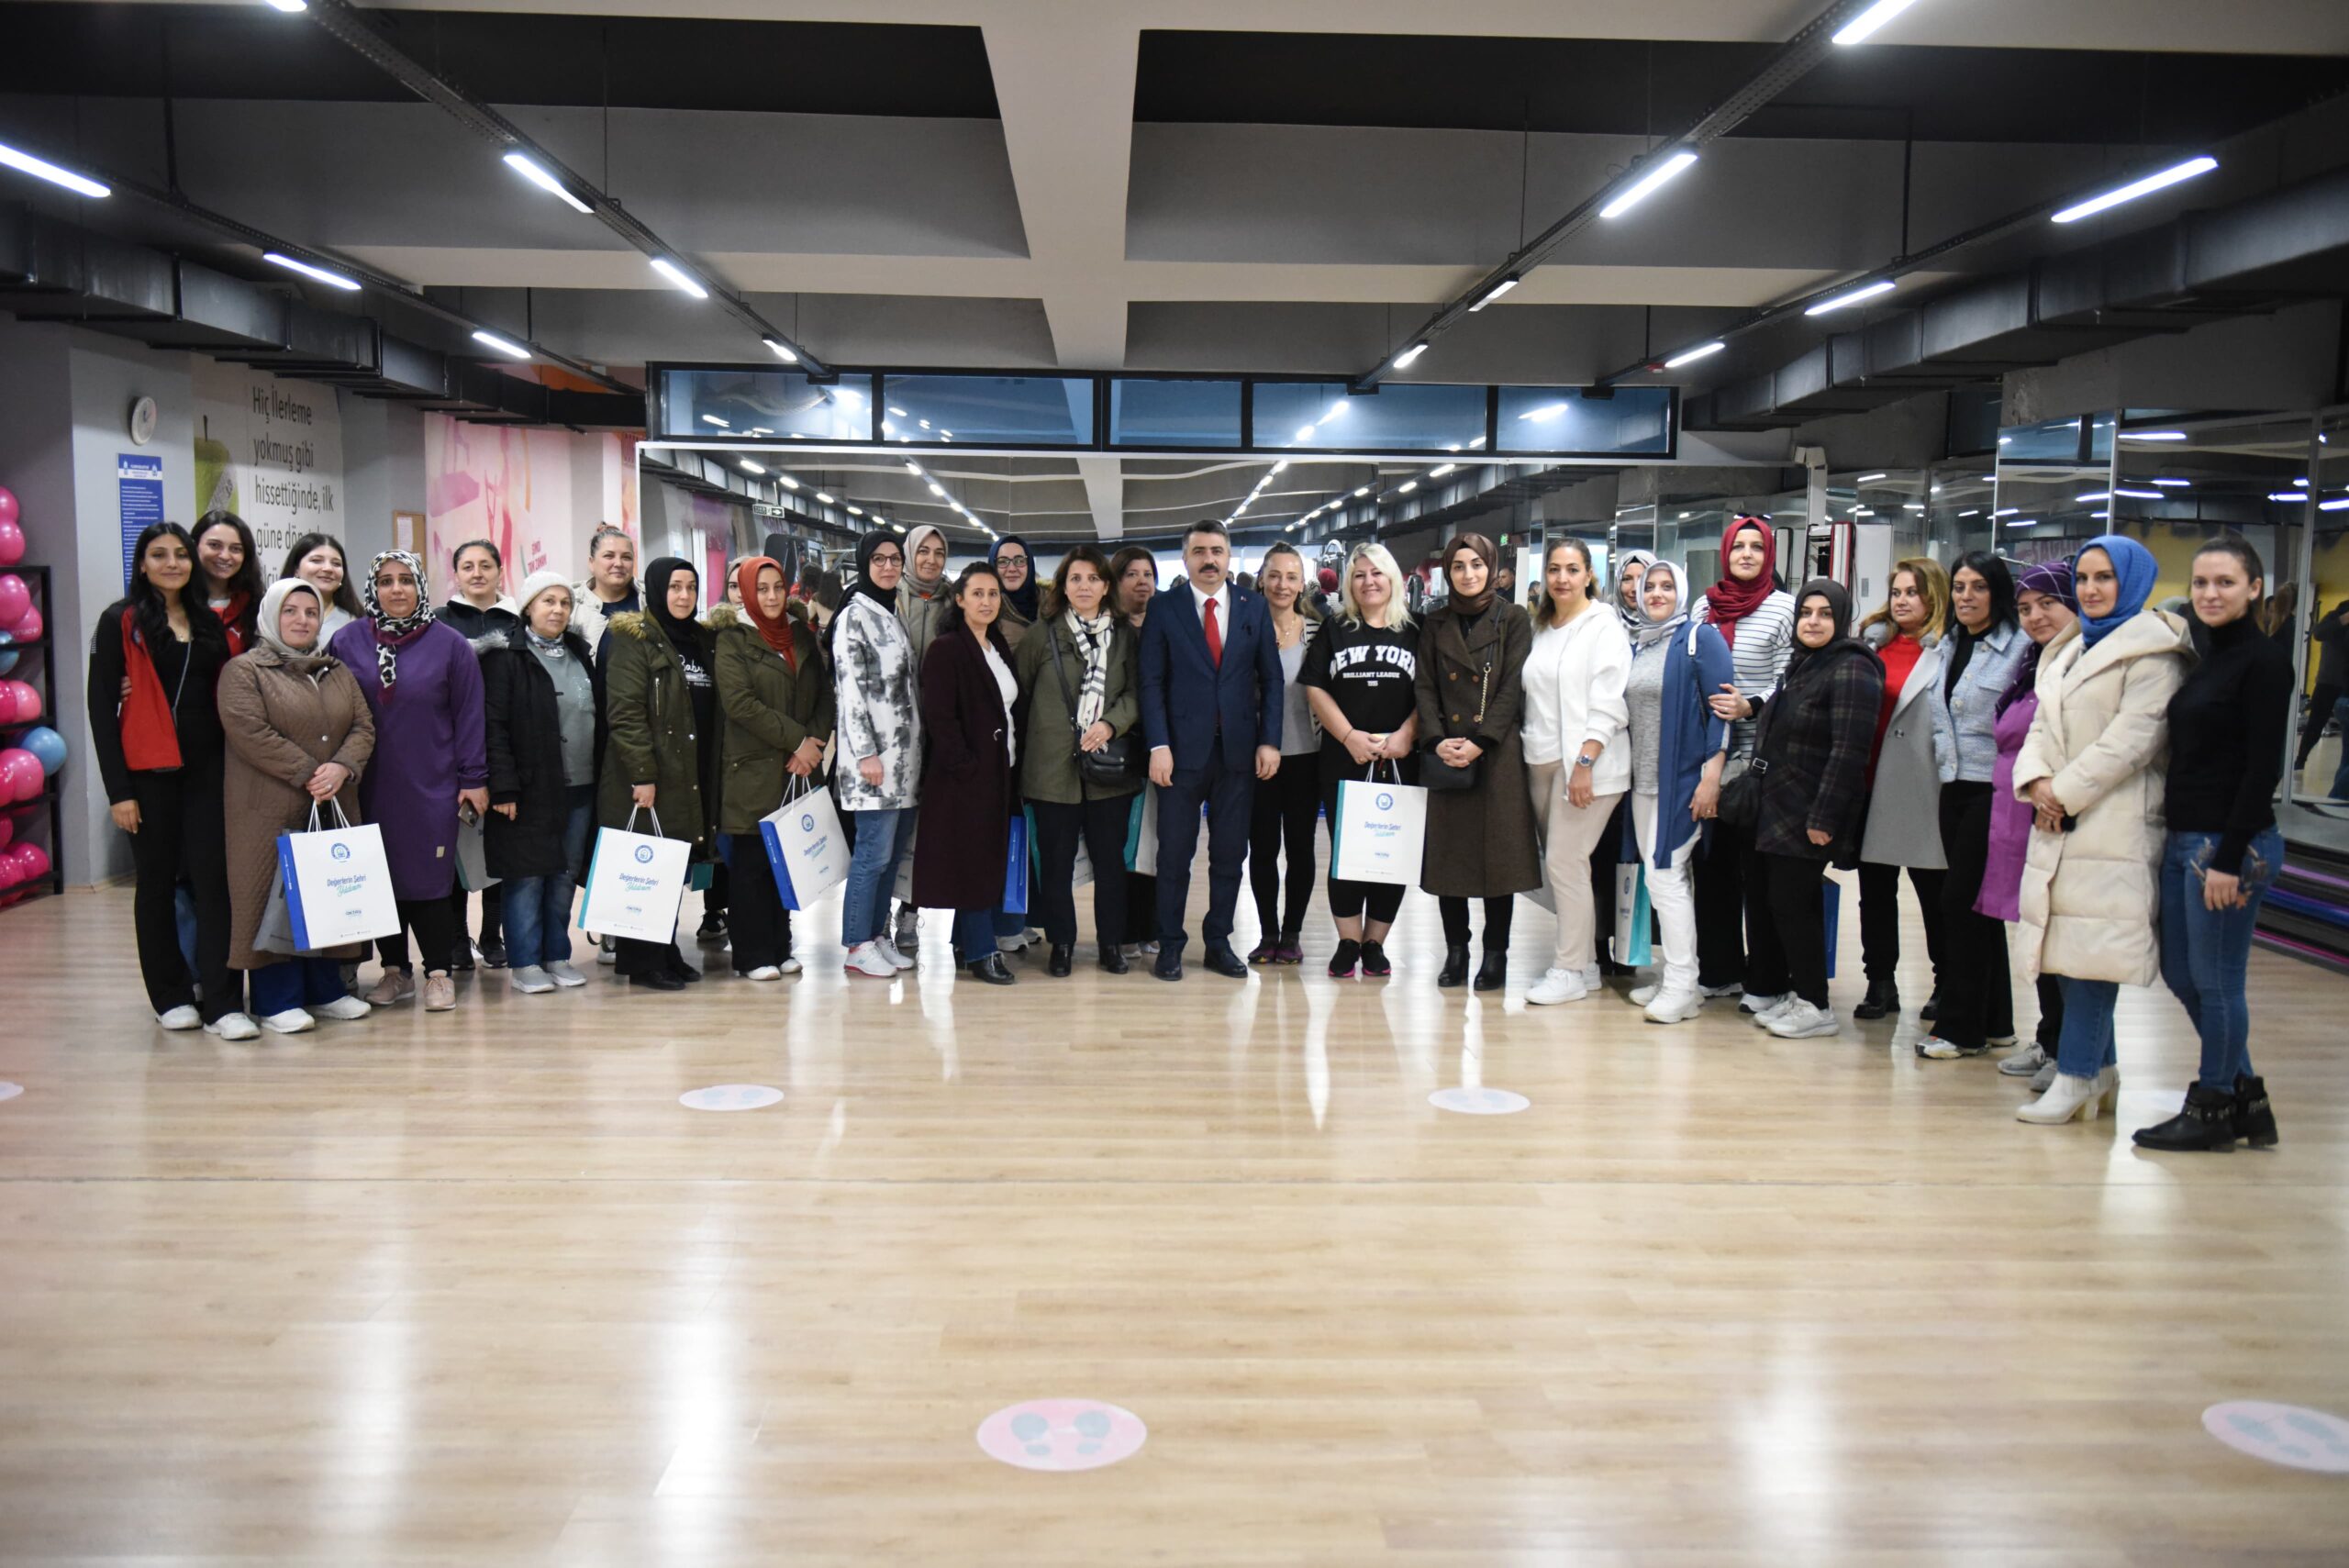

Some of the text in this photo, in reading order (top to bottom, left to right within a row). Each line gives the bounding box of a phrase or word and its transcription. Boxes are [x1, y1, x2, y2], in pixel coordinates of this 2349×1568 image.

[252, 383, 312, 426] Hiç İlerleme
[253, 432, 314, 473] yokmuş gibi
[255, 474, 335, 515] hissettiğinde, ilk
[257, 522, 282, 556] güne
